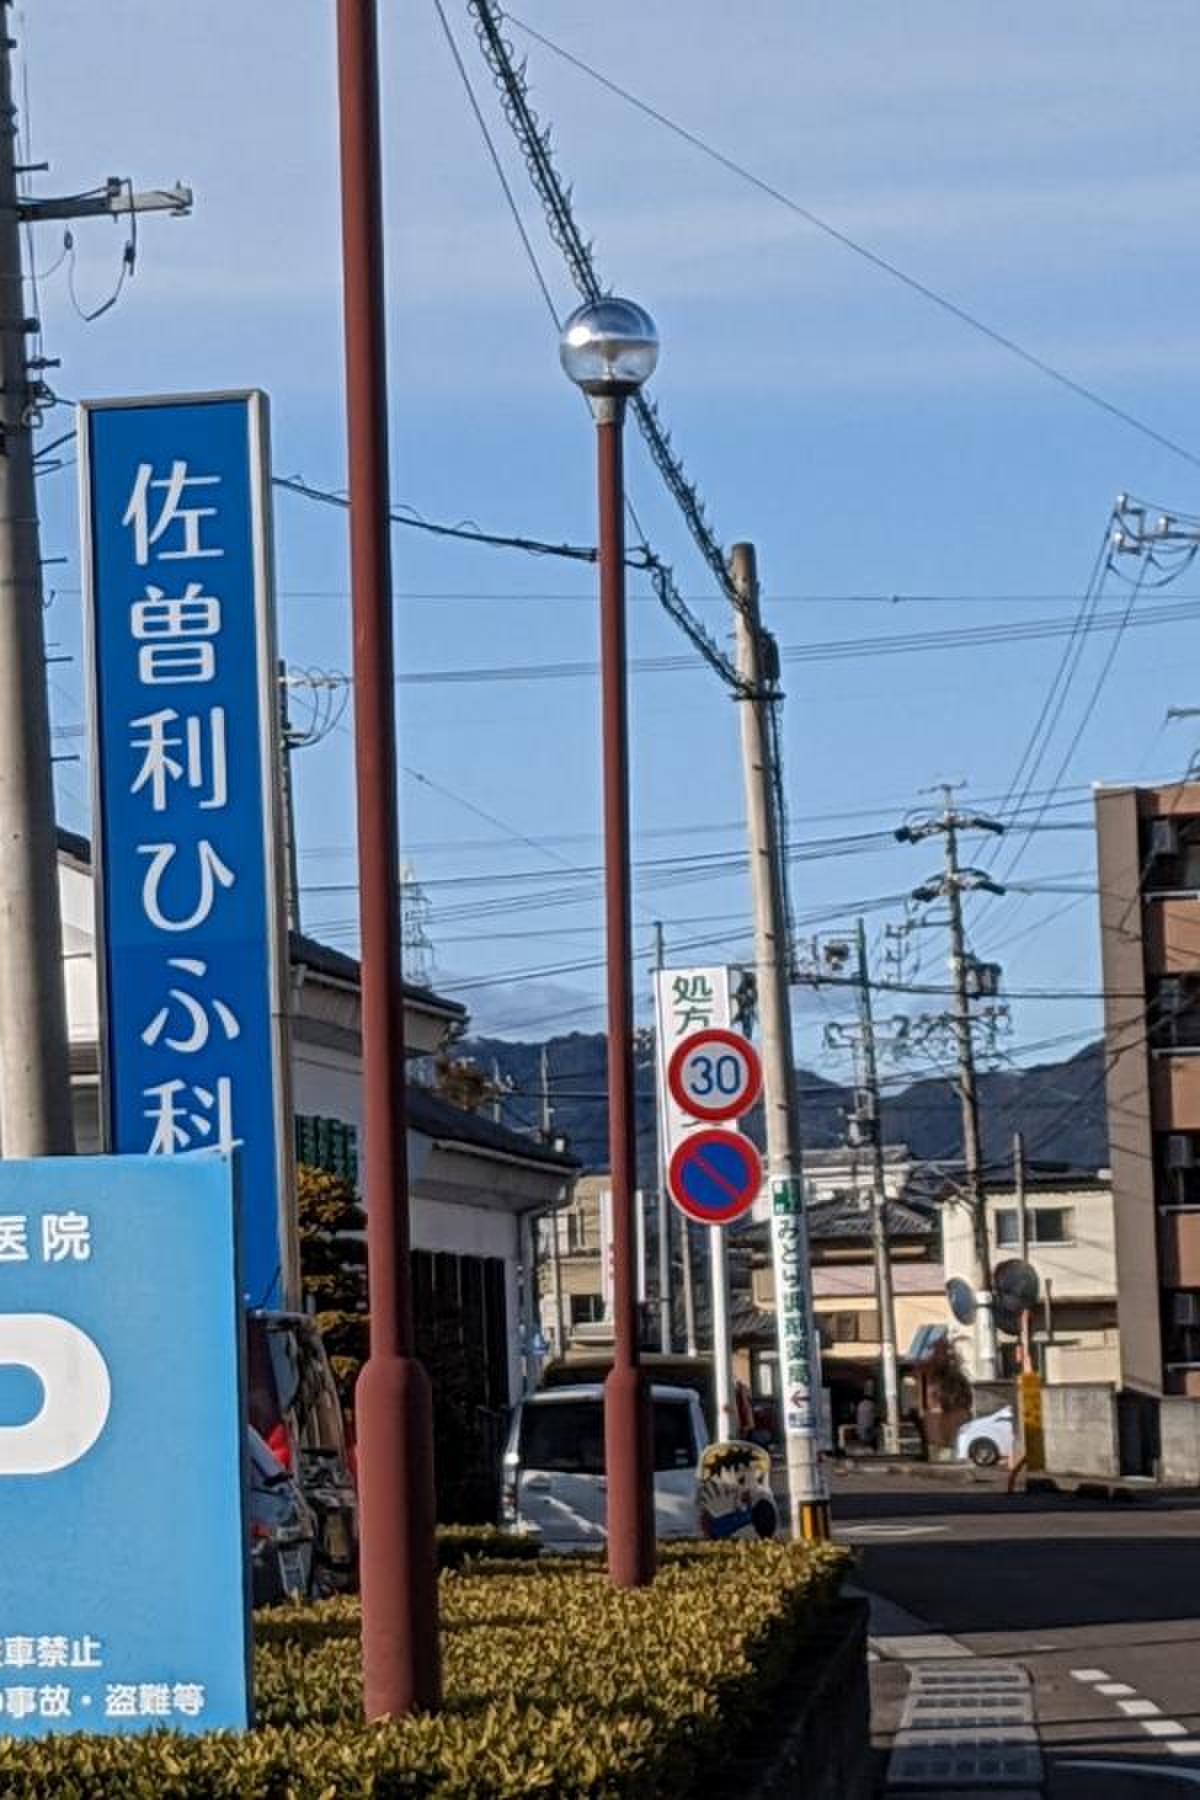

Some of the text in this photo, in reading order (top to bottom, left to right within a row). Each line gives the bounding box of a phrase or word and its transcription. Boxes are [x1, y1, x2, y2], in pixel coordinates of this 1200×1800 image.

[121, 459, 244, 1154] 佐曽利ひふ科
[689, 1055, 741, 1096] 30
